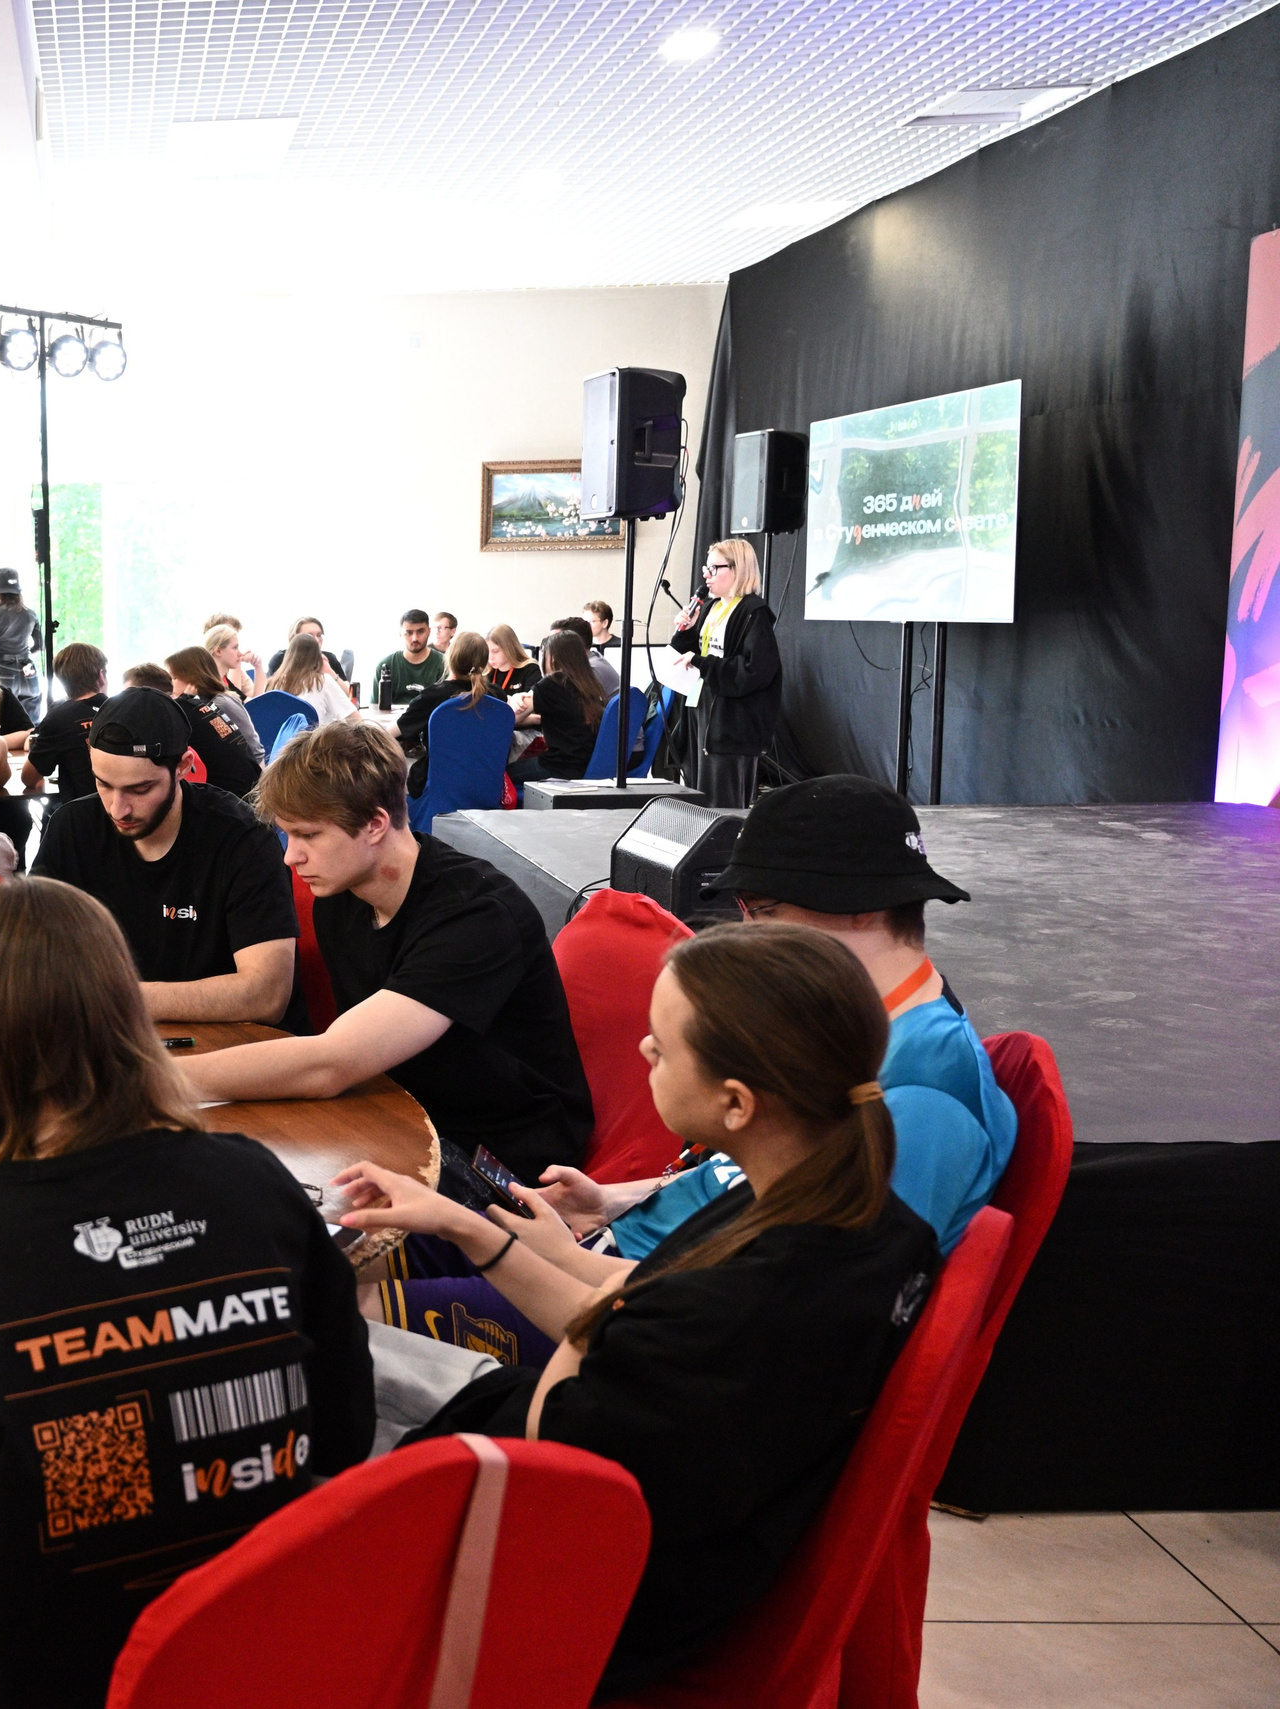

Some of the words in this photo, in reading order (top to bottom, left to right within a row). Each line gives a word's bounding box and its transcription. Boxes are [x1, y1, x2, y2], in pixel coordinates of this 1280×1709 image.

[862, 493, 898, 514] 365
[900, 488, 943, 513] дней
[825, 518, 941, 546] Студенческом
[124, 1210, 175, 1235] RUDN
[129, 1219, 207, 1247] university
[15, 1286, 292, 1373] TEAMMATE
[180, 1429, 311, 1503] inside
